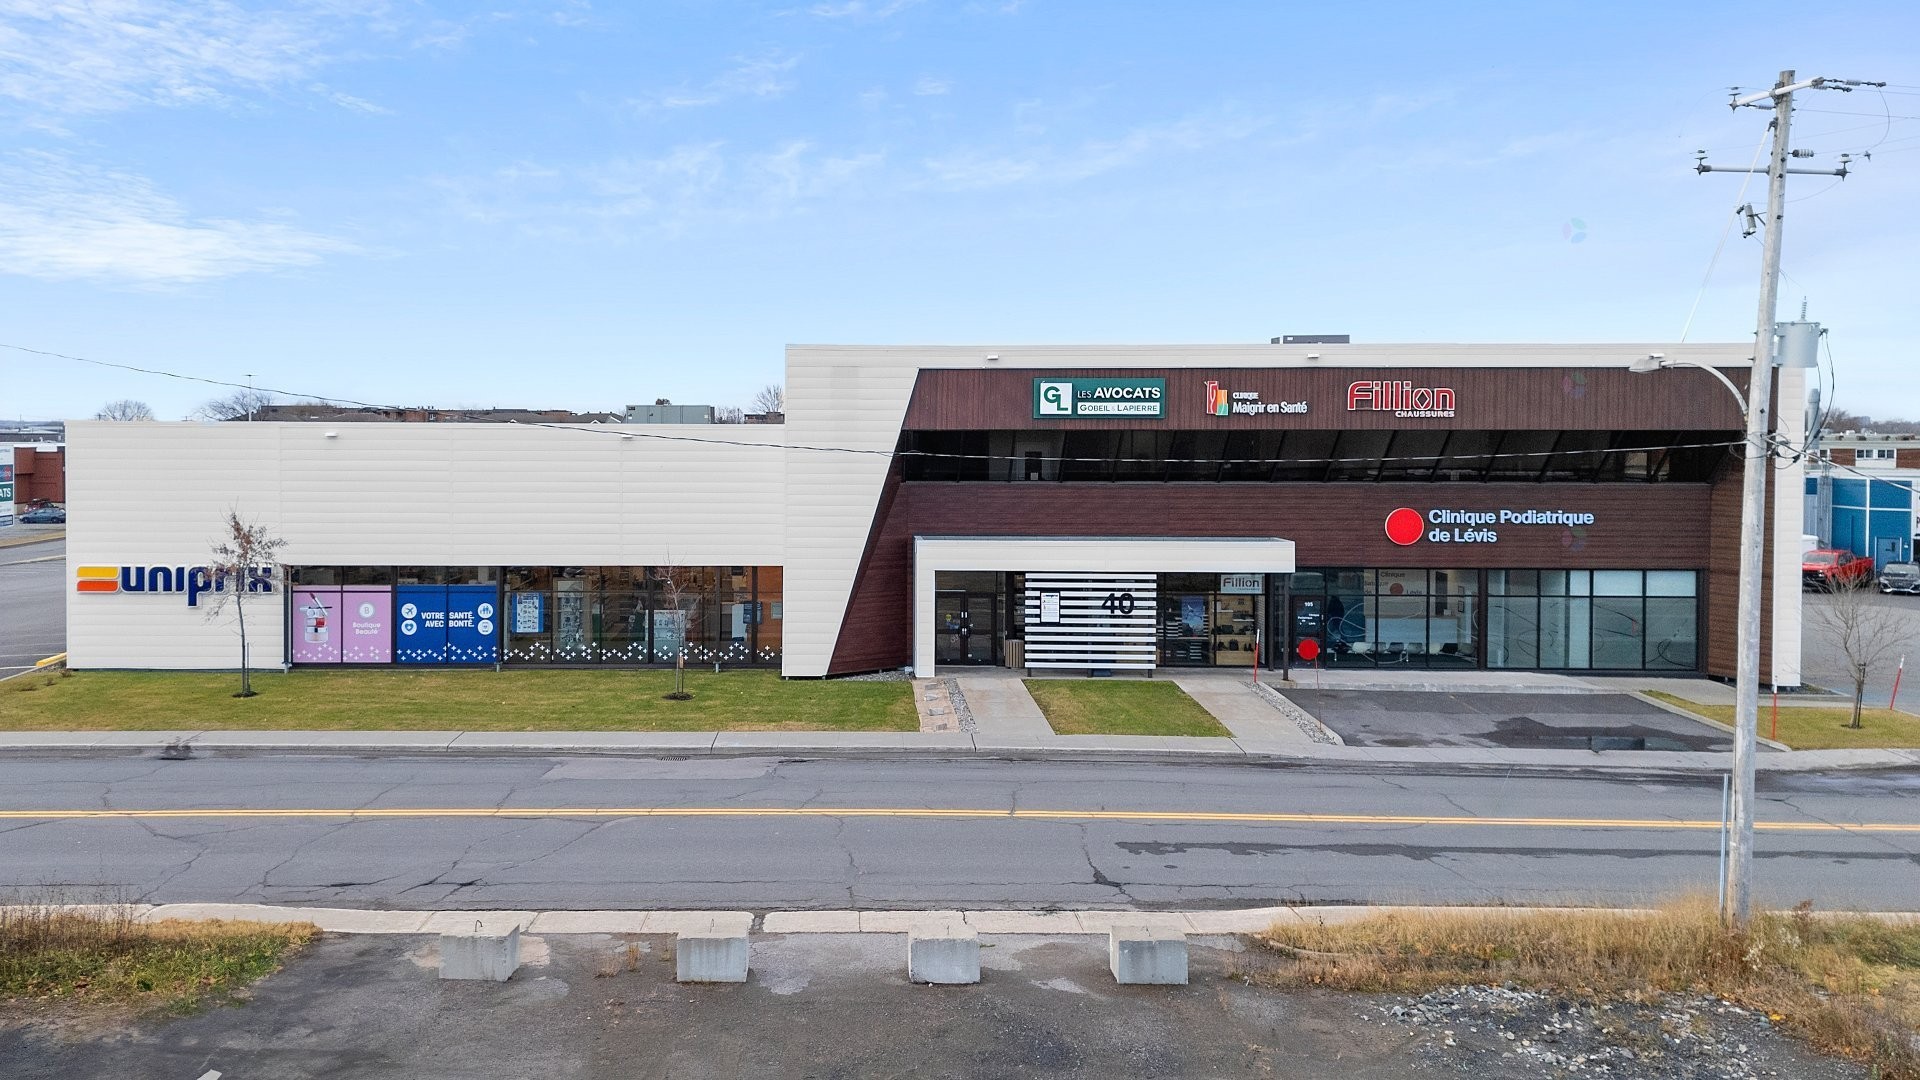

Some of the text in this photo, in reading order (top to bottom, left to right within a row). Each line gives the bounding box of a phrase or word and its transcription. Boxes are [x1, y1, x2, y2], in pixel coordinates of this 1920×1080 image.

[1078, 387, 1160, 399] LES AVOCATS
[1348, 381, 1455, 410] Fillion
[1233, 401, 1307, 415] Maigrir en Santé
[1428, 510, 1595, 527] Clinique Podiatrique
[1428, 528, 1497, 542] de Lévis
[1223, 577, 1260, 588] Fillion
[1101, 593, 1135, 614] 40
[421, 612, 445, 620] VOTRE
[352, 622, 381, 630] Boutique
[425, 620, 445, 628] AVEC
